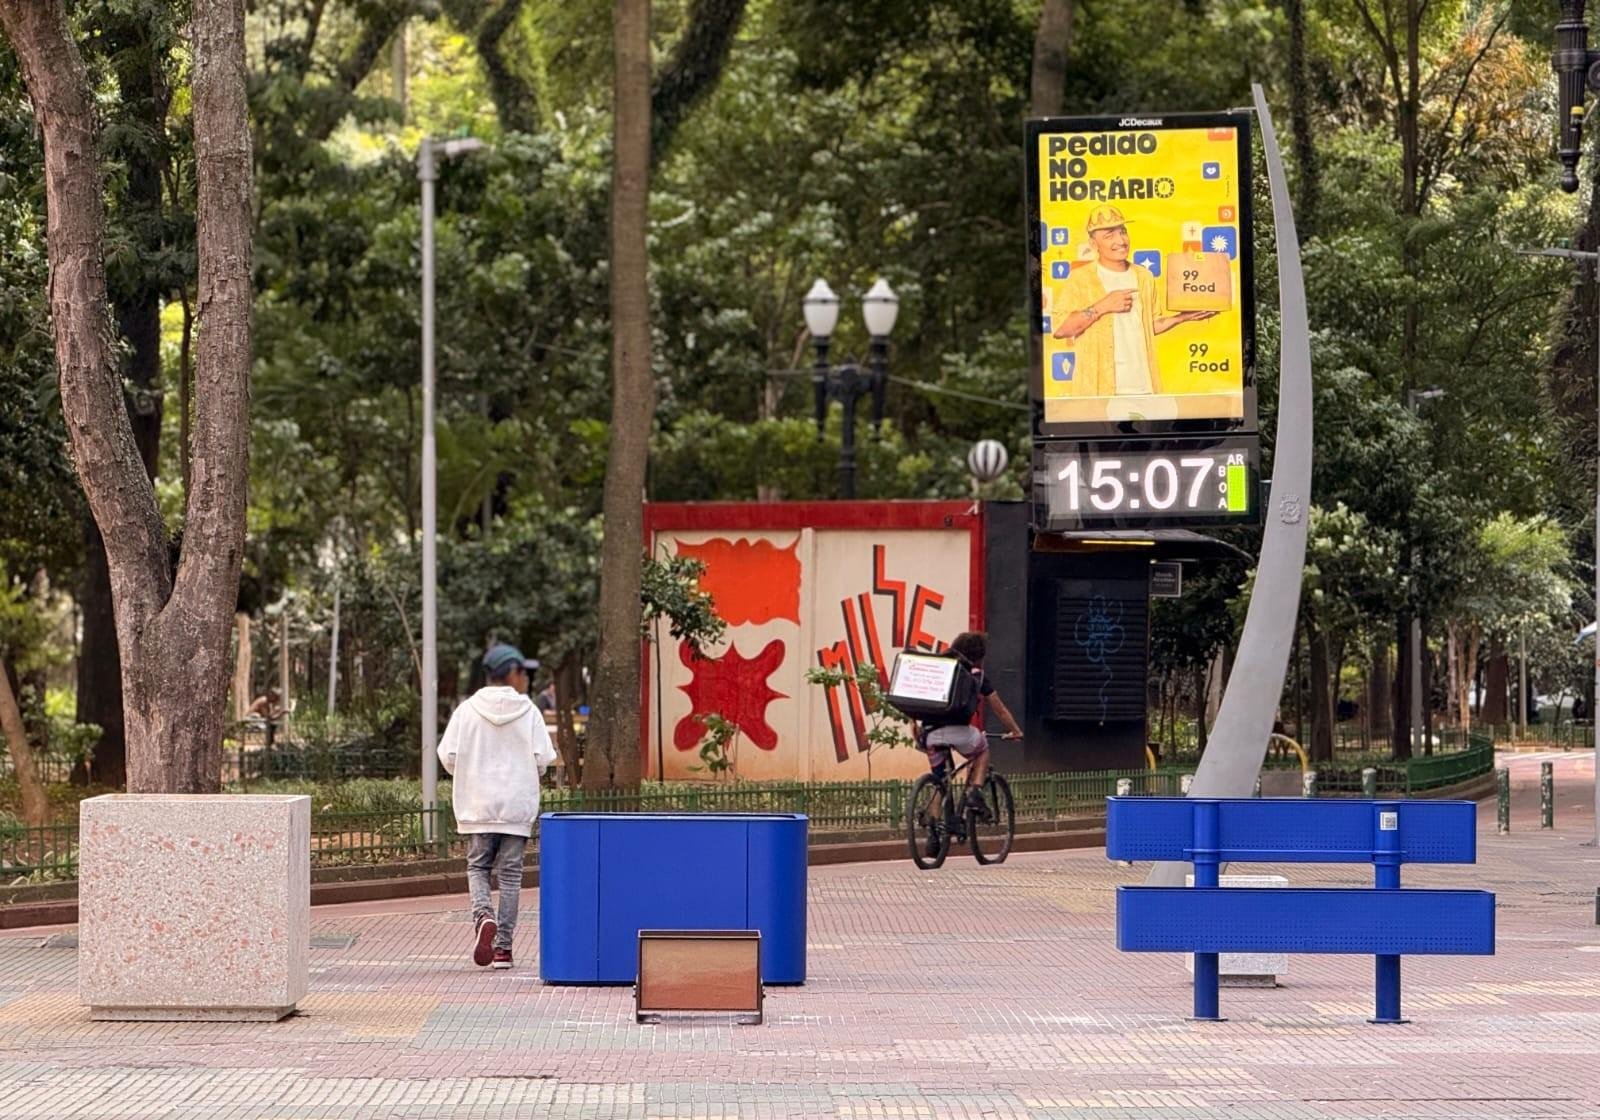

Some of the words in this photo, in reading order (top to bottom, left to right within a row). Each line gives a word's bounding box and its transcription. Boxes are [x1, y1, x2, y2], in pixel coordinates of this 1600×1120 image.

[1119, 118, 1163, 127] JCDecaux
[1049, 158, 1088, 179] NO
[1049, 176, 1175, 203] HORÁRIO
[1182, 270, 1199, 281] 99
[1182, 282, 1216, 293] Food
[1188, 343, 1208, 357] 99
[1189, 359, 1230, 373] Food
[1226, 453, 1245, 465] AR
[1058, 458, 1214, 511] 15:07
